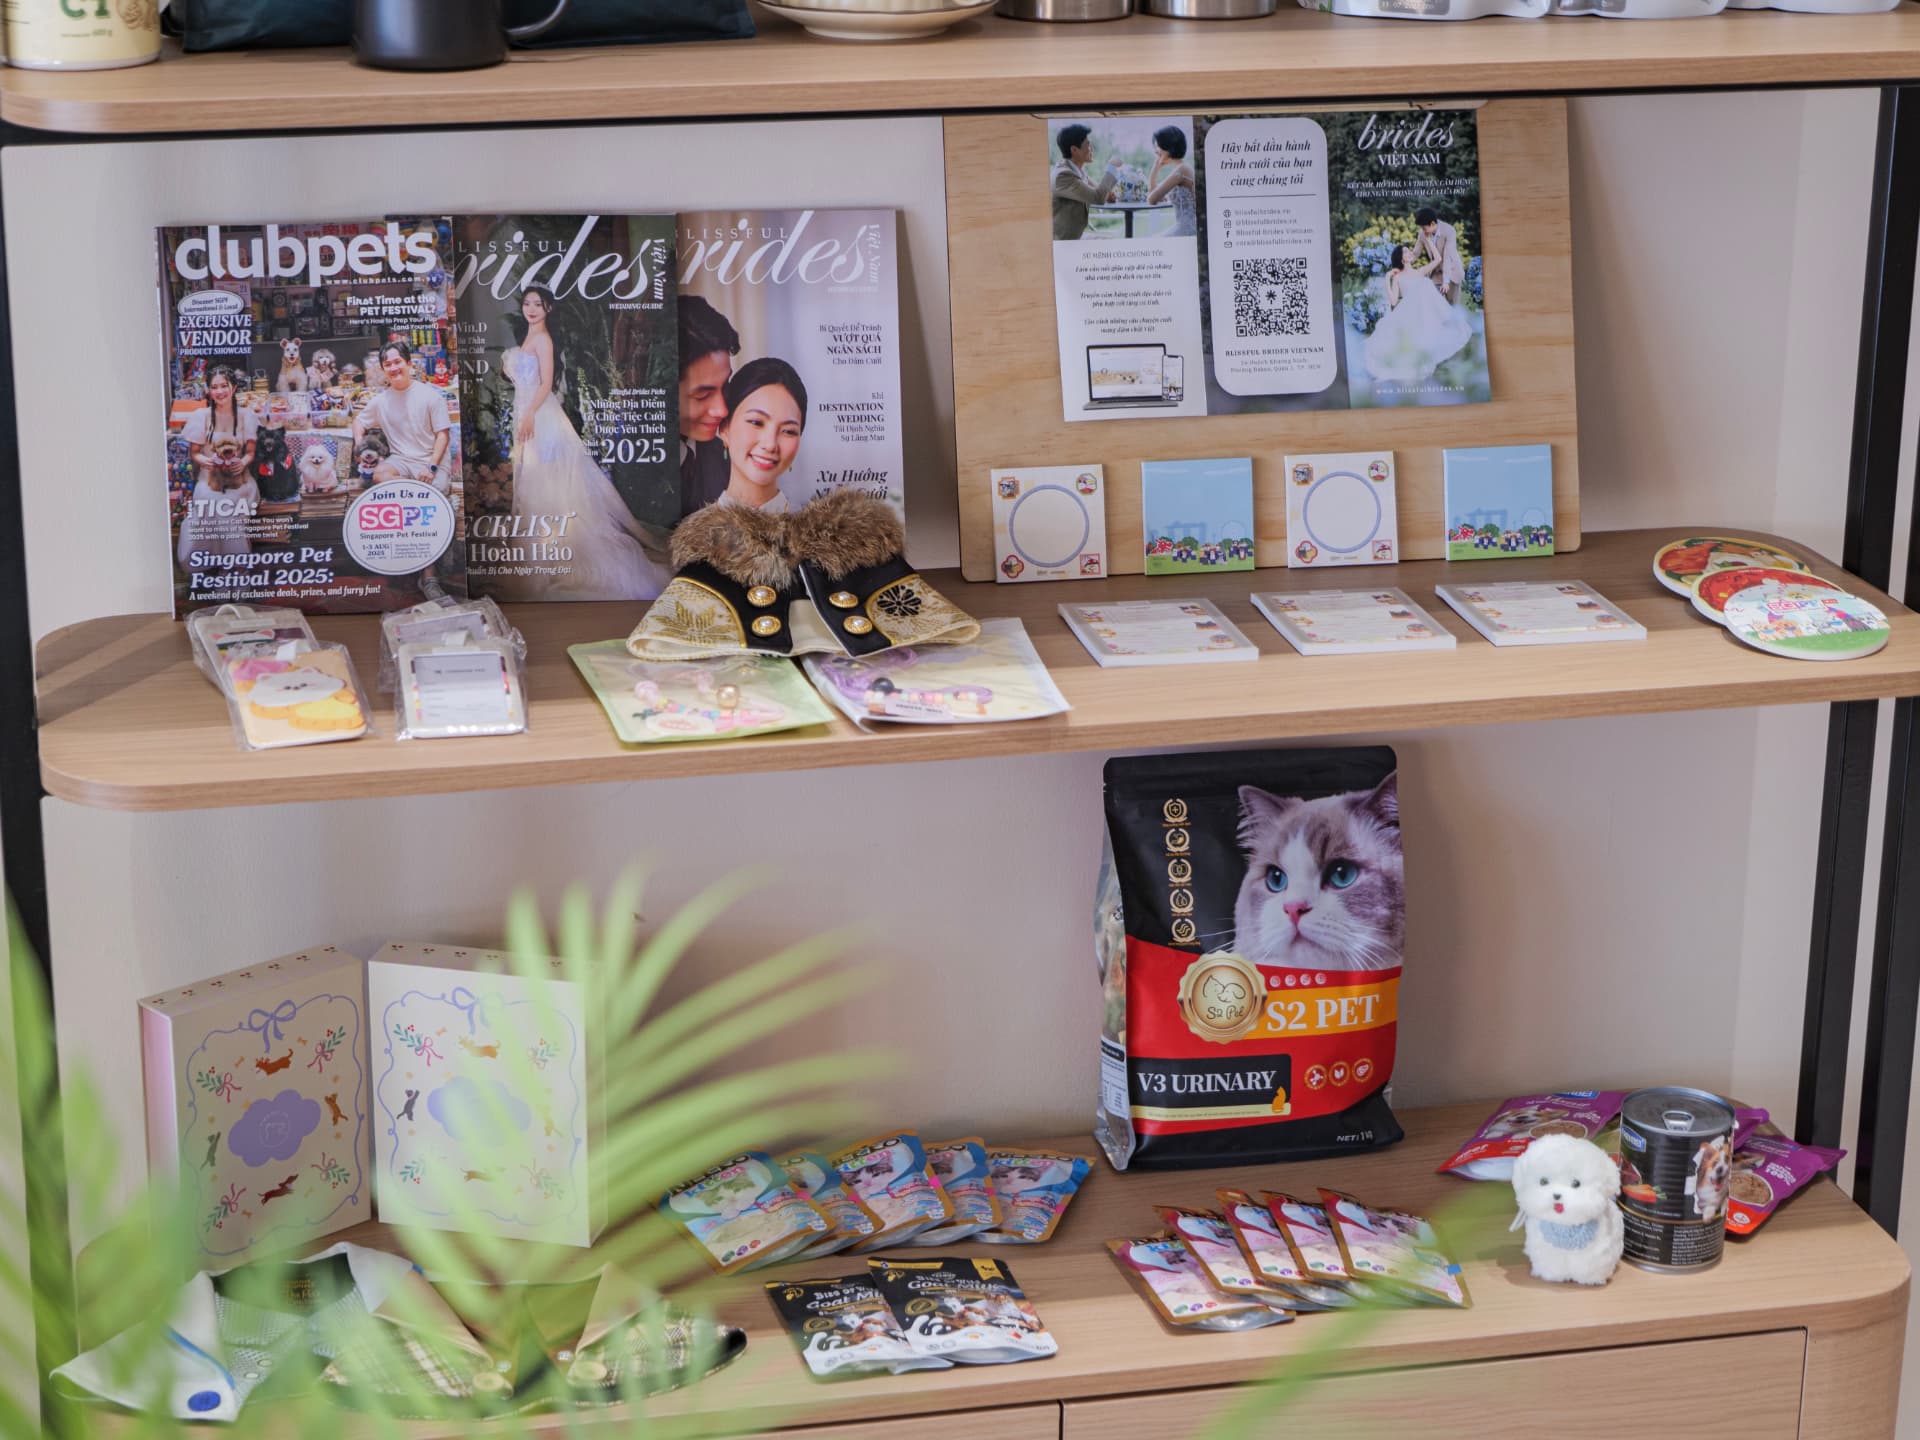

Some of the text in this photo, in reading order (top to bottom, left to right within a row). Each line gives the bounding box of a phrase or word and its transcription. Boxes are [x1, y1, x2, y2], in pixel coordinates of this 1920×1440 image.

[1358, 112, 1455, 150] brides
[1221, 142, 1241, 155] Hãy
[1285, 139, 1311, 151] hành
[1220, 156, 1313, 171] trình cưới của bạn
[1378, 151, 1441, 168] VIỆT NAM
[1230, 173, 1304, 187] cùng chúng tôi
[687, 228, 789, 239] LISSFUL
[458, 239, 568, 252] LISSFUL
[680, 210, 867, 285] rides
[175, 222, 437, 287] clubpets
[455, 216, 652, 300] rides
[346, 294, 436, 306] First Time at the
[360, 305, 436, 316] PET FESTIVAL?
[178, 314, 252, 329] EXCLUSIVE
[179, 329, 252, 347] VENDOR
[861, 332, 881, 343] QUÁ
[180, 346, 252, 355] PRODUCT SHOWCASE
[855, 343, 881, 353] SÁCH
[590, 396, 666, 410] Những Địa Điểm
[818, 402, 884, 412] DESTINATION
[595, 411, 620, 421] Chức
[621, 411, 642, 423] Tiệc
[644, 410, 666, 421] Cưới
[836, 414, 885, 423] WEDDING
[620, 424, 637, 434] Yêu
[639, 423, 666, 433] Thích
[600, 438, 666, 464] 2025
[816, 467, 888, 484] Xu Hướng
[370, 491, 396, 501] Join
[400, 490, 414, 499] Us
[360, 504, 437, 530] SGPF
[360, 532, 394, 541] Singapore
[411, 530, 438, 538] Festival
[190, 547, 334, 570] Singapore Pet
[471, 540, 574, 562] Hoàn Hảo
[191, 567, 335, 589] Festival 2025:
[497, 566, 513, 575] Cho
[513, 566, 533, 576] Ngày
[189, 584, 381, 600] A weekend of exclusive deals, prizes, and furry fun!
[1206, 1004, 1245, 1020] S2 Pet
[1266, 994, 1380, 1032] S2 PET
[1137, 1070, 1277, 1094] V3 URINARY
[806, 1296, 848, 1309] Goat
